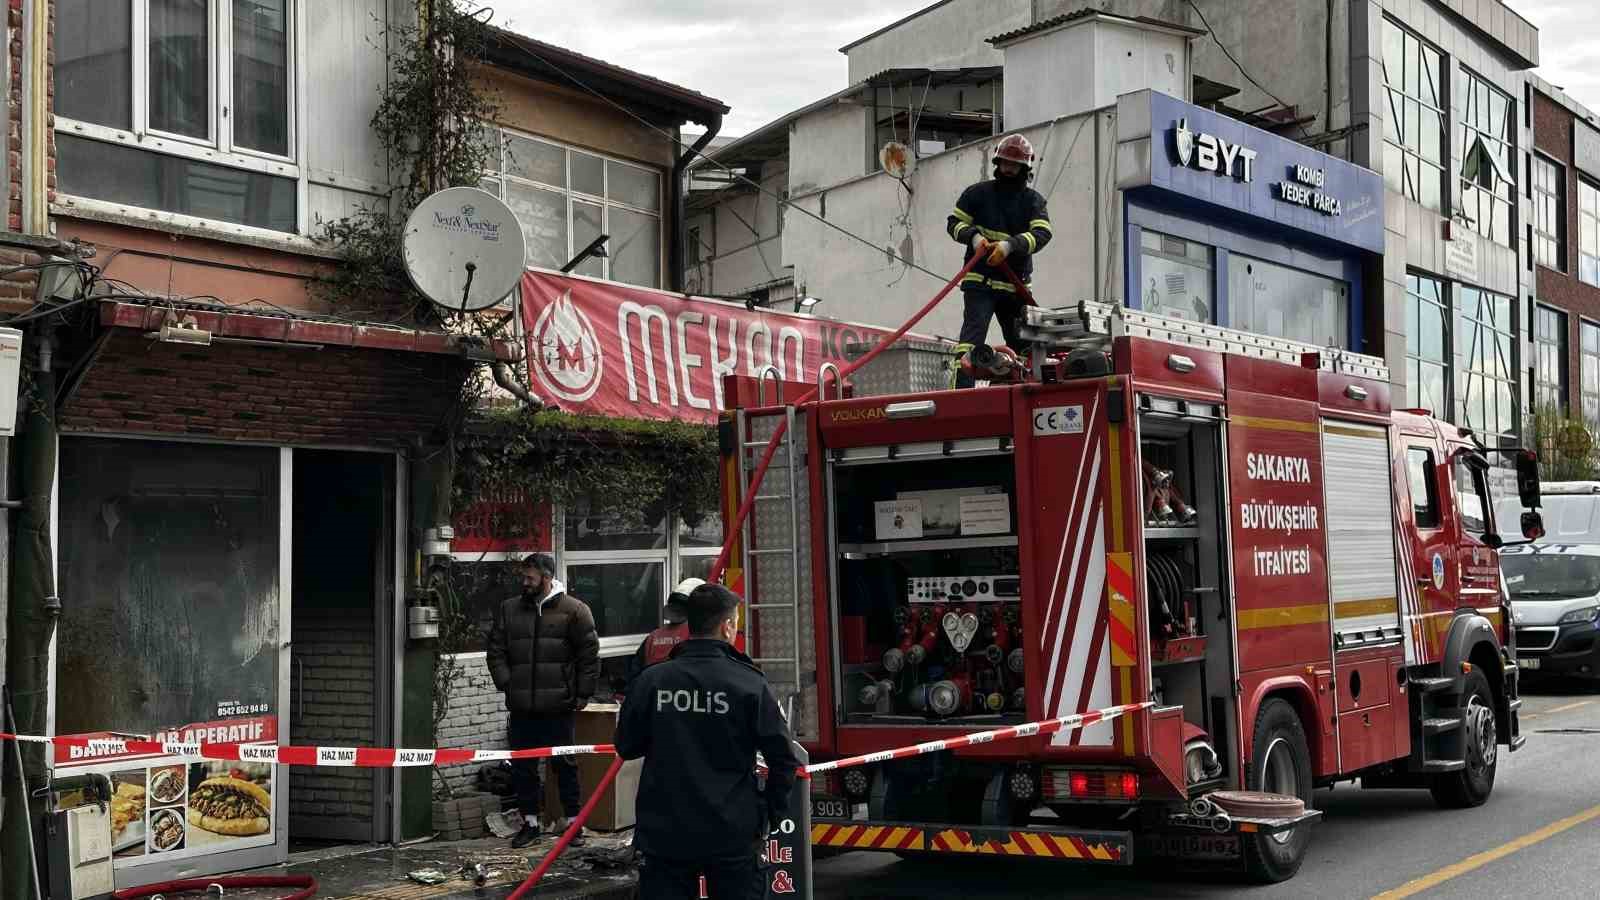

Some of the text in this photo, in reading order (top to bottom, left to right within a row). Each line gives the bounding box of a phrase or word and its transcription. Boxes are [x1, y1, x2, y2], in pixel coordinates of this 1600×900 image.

[1198, 133, 1257, 183] BYT
[1280, 182, 1311, 206] YEDEK
[1314, 190, 1342, 216] PARÇA
[1247, 452, 1311, 483] SAKARYA
[1241, 498, 1319, 536] BÜYÜKŞEHİR
[1254, 544, 1310, 576] İTFAİYESİ
[184, 721, 264, 746] APERATİF
[243, 749, 276, 759] HAZ MAT
[321, 751, 354, 761] HAZ MAT
[400, 752, 433, 762] HAZ MAT
